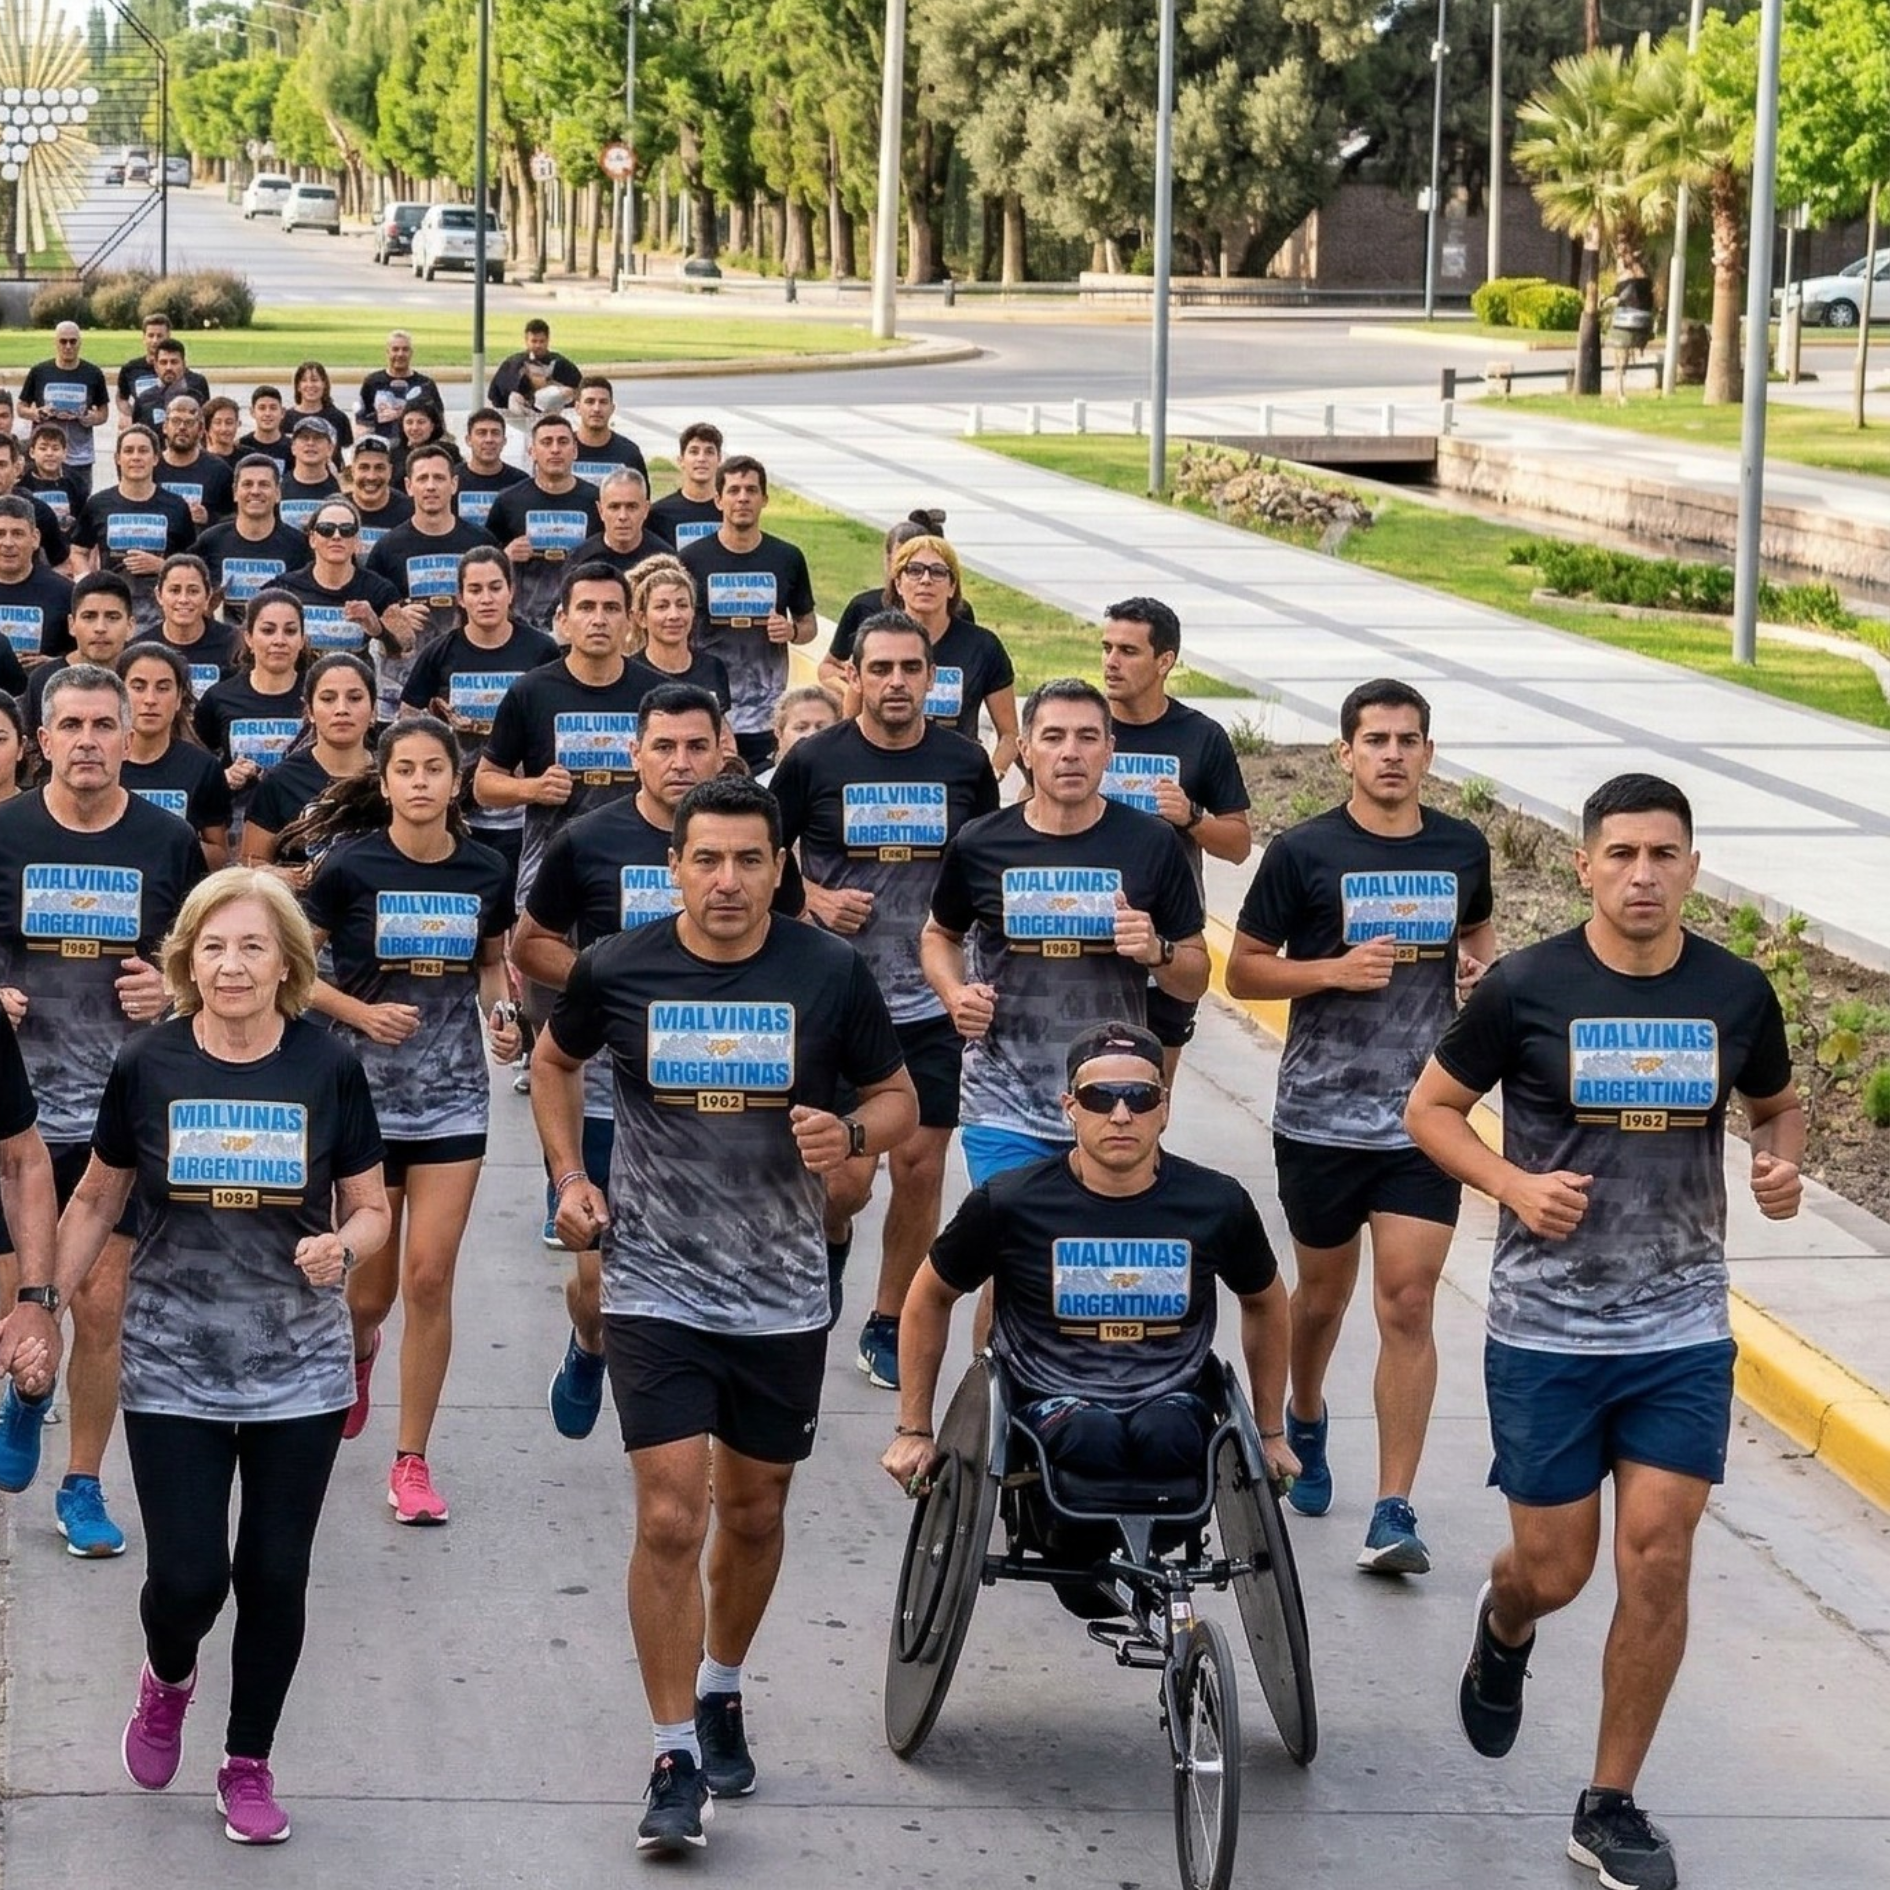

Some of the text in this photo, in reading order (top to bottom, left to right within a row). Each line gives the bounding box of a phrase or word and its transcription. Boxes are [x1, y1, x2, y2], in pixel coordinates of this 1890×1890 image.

[26, 868, 139, 893] MALVINAS
[1345, 875, 1456, 898] MALVINAS
[654, 1007, 788, 1031] MALVINAS
[1576, 1023, 1713, 1049] MALVINAS
[655, 1062, 788, 1085] ARGENTINAS
[173, 1104, 302, 1130] MALVINAS
[1624, 1114, 1663, 1127] 1982
[172, 1156, 302, 1183] ARGENTINAS
[1056, 1242, 1187, 1267] MALVINAS
[1057, 1293, 1187, 1316] ARGENTINAS
